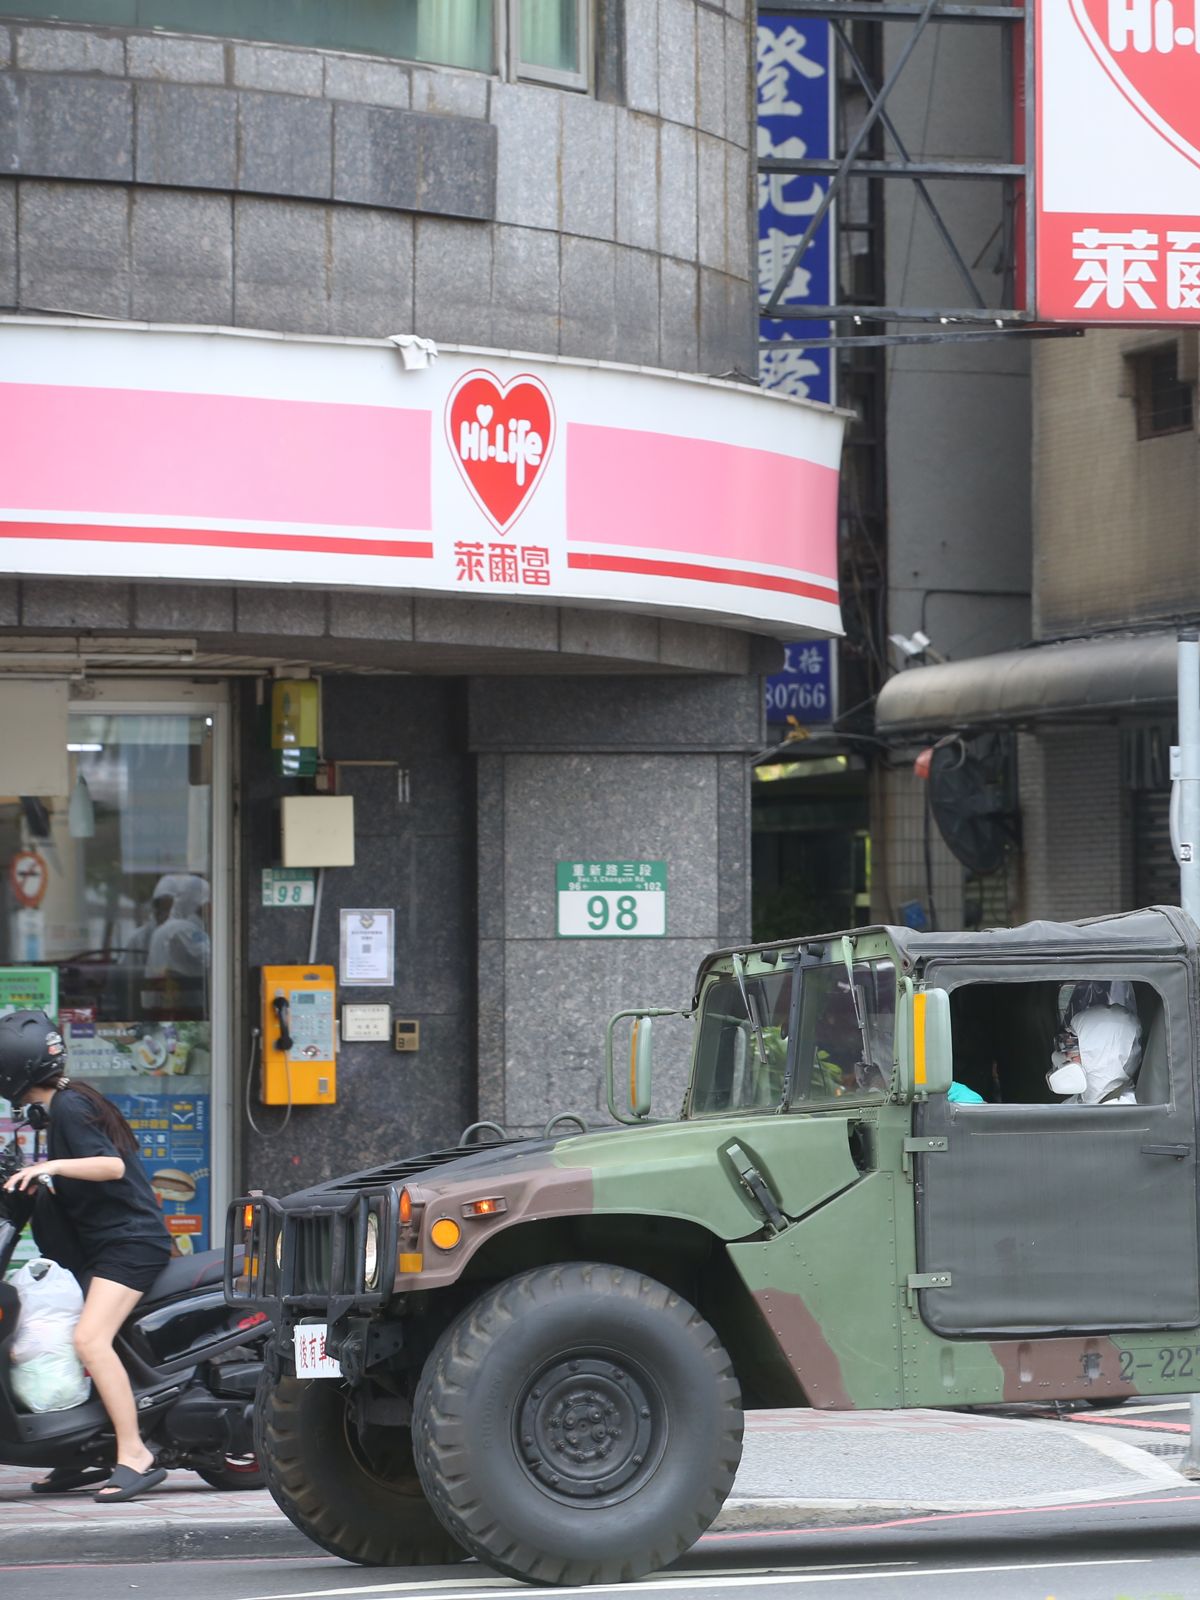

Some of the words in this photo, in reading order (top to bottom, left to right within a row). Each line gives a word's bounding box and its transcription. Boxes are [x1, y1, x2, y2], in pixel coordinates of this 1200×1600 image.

[454, 541, 551, 586] 萊爾富
[572, 863, 652, 877] 重新路三段
[277, 886, 302, 903] 98
[643, 882, 661, 891] 102
[587, 895, 638, 931] 98
